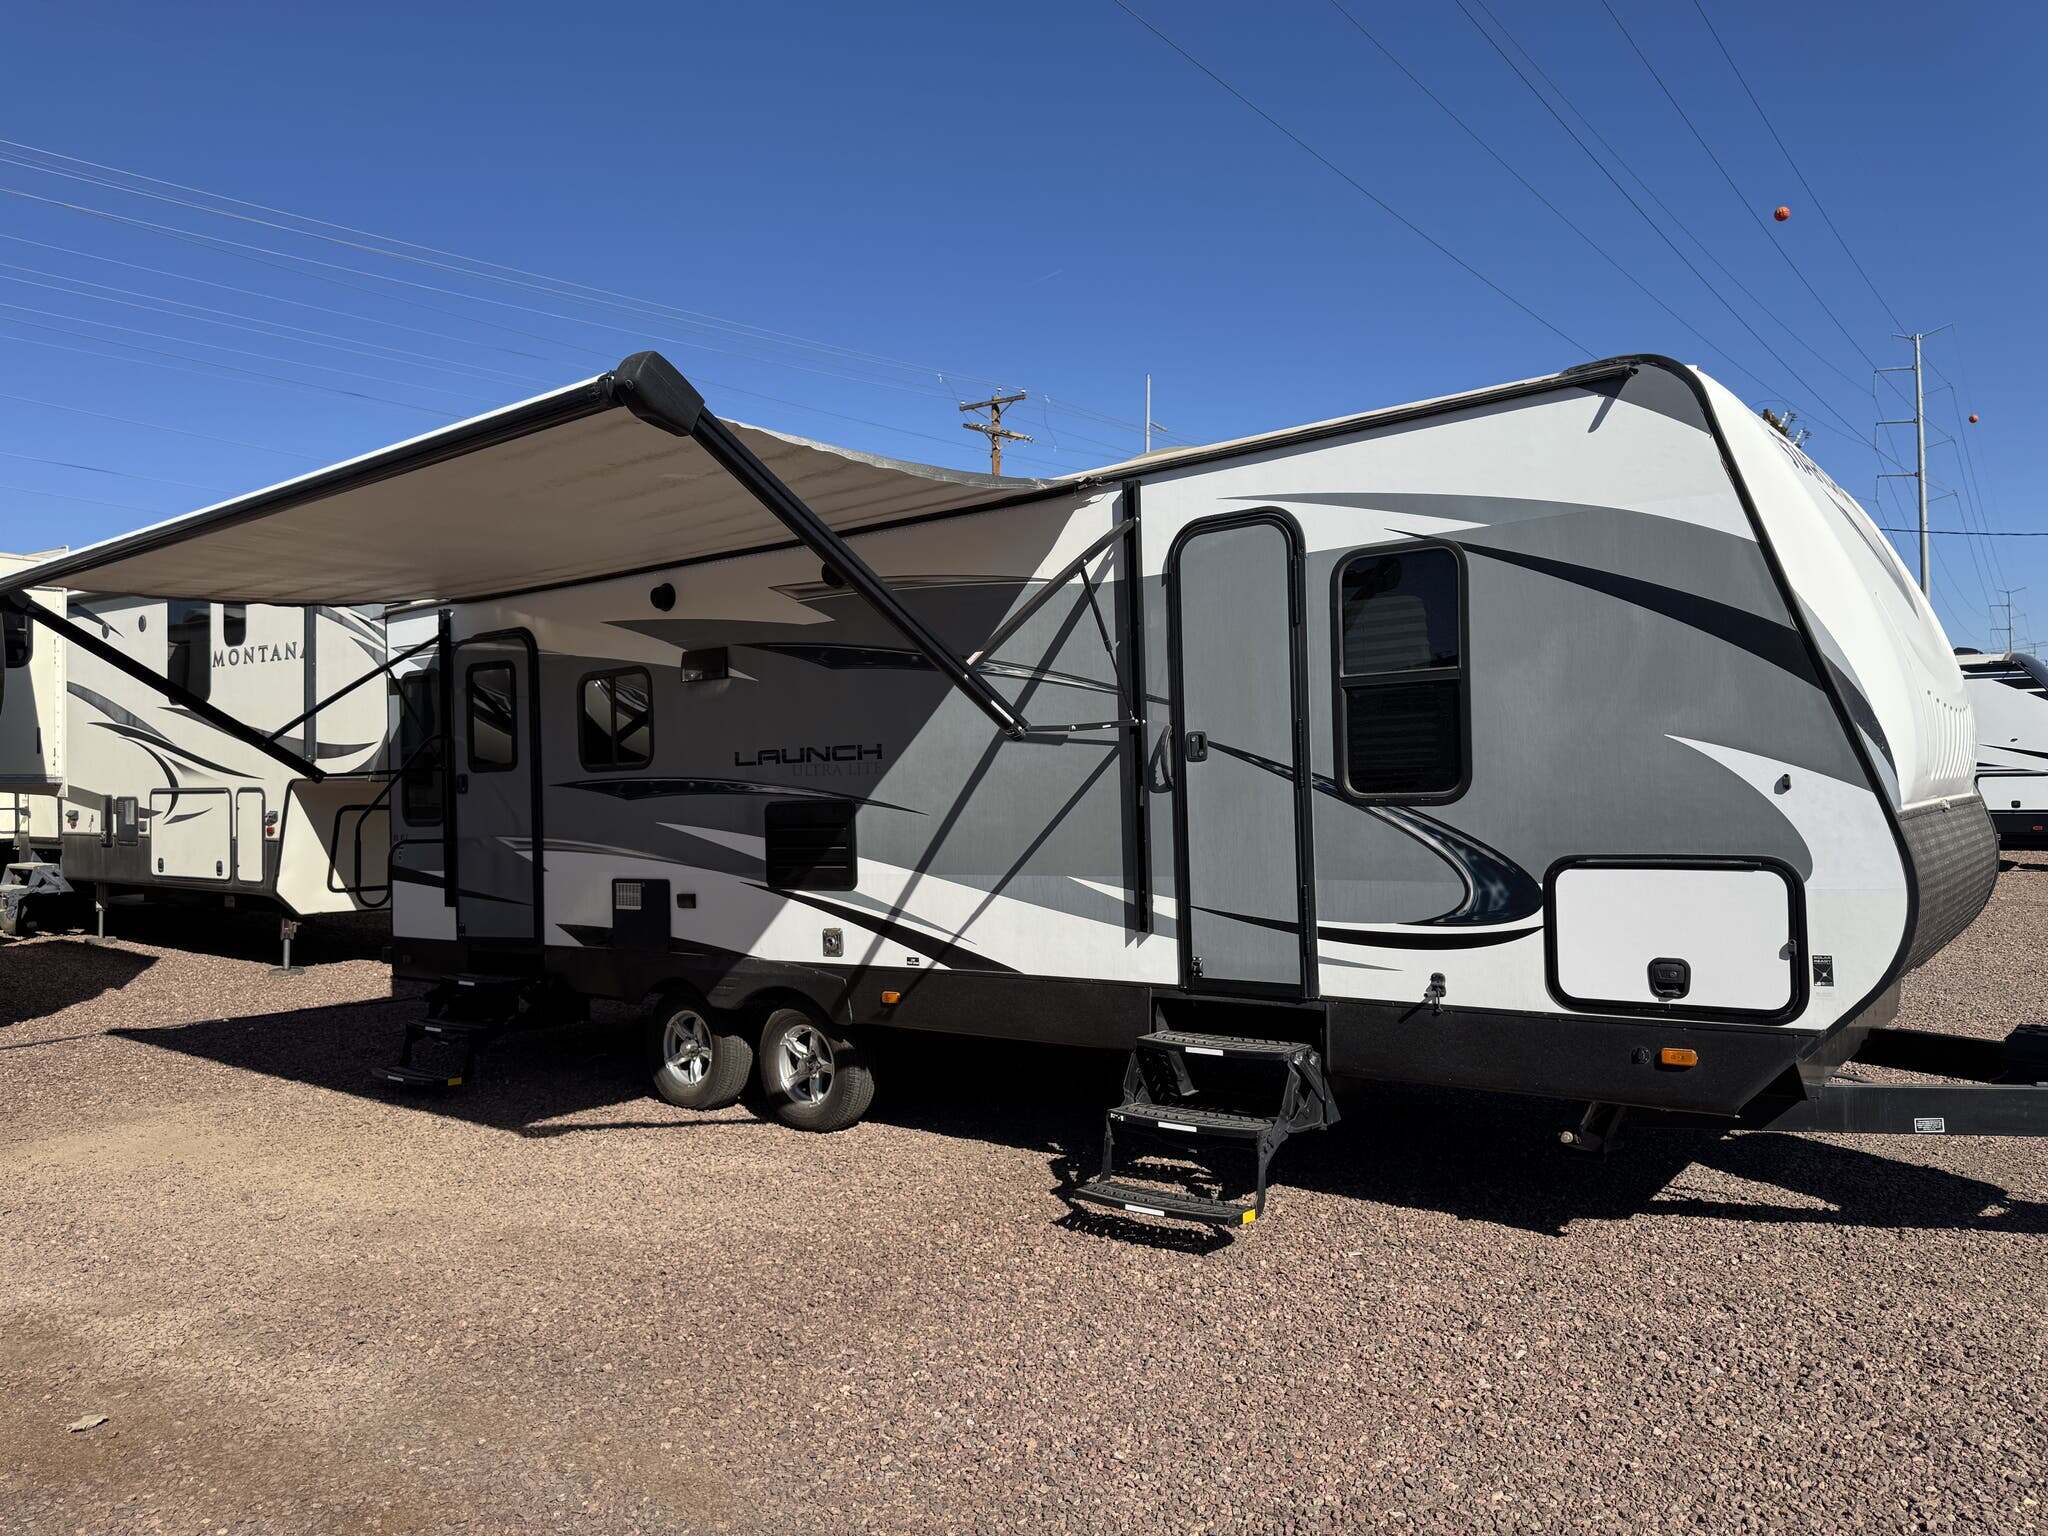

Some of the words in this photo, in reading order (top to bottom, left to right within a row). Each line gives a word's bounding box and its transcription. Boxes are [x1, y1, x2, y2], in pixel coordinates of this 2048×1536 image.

[734, 743, 883, 766] LAUNCH
[793, 763, 842, 777] ULTRA
[848, 761, 882, 777] LITE
